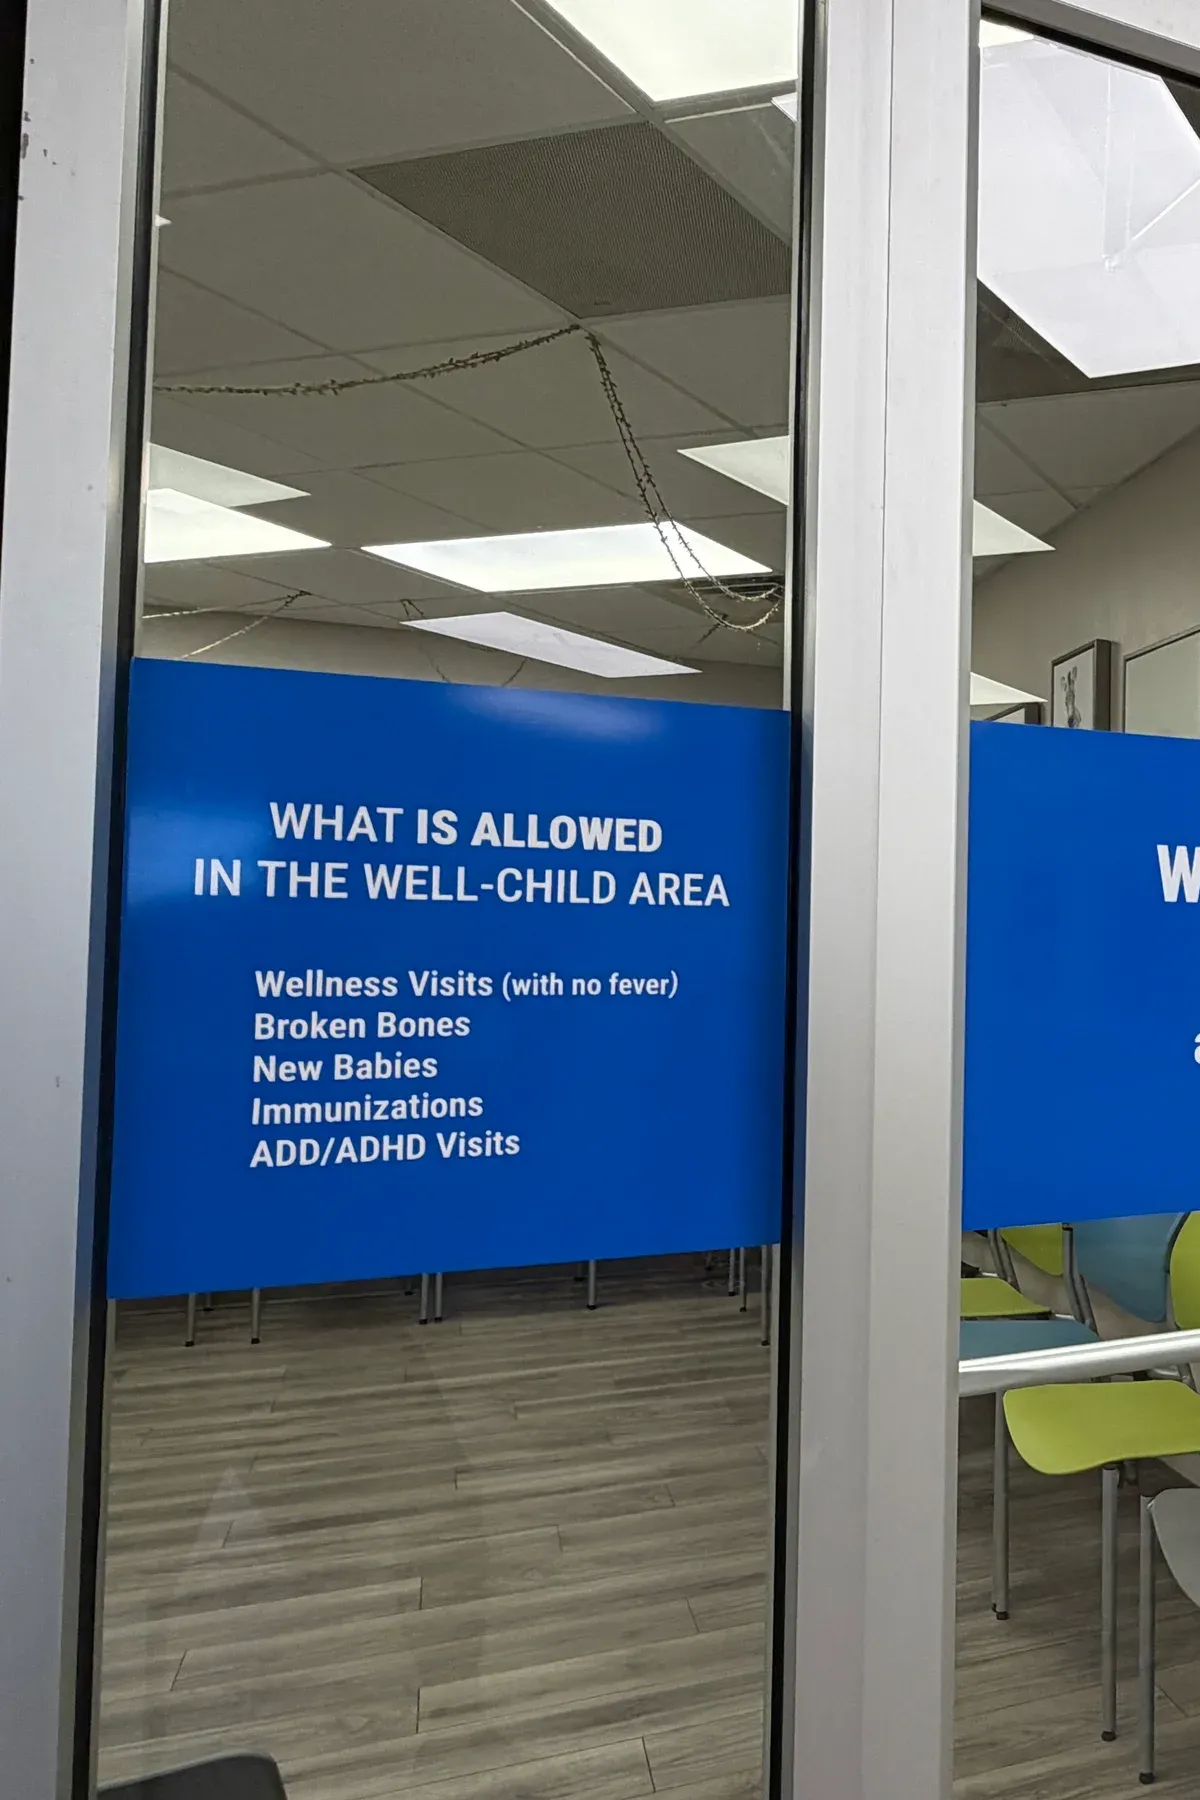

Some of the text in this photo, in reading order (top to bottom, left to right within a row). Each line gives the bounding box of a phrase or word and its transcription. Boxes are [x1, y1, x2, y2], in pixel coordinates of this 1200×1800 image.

[270, 803, 662, 852] WHAT IS ALLOWED
[195, 859, 729, 906] IN THE WELL-CHILD AREA
[256, 970, 677, 1001] Wellness Visits (with no fever)
[255, 1011, 470, 1039] Broken Bones
[254, 1052, 437, 1082] New Babies
[252, 1093, 482, 1124] Immunizations
[250, 1131, 519, 1167] ADD/ADHD Visits
